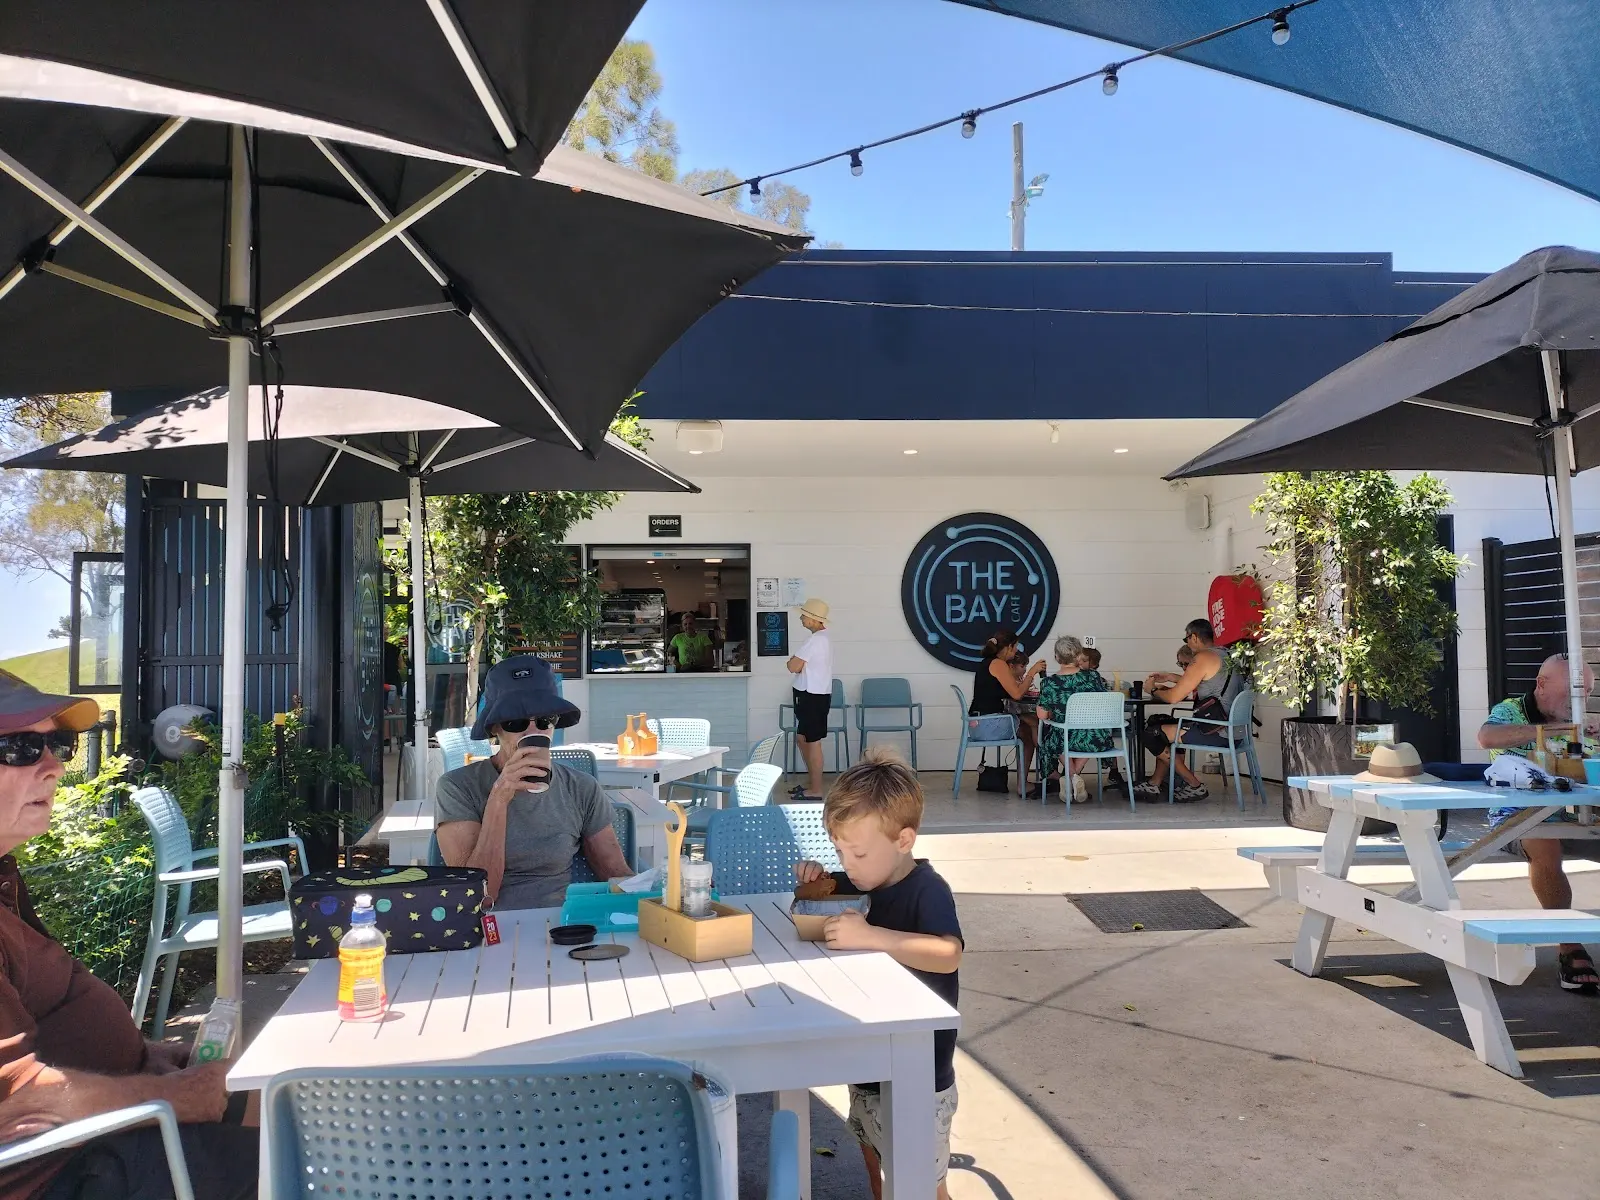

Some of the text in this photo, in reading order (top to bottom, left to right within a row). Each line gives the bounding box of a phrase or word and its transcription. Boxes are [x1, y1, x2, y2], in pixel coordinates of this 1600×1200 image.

[948, 561, 1015, 590] THE
[945, 594, 1009, 623] BAY
[1010, 595, 1021, 623] CAFE
[487, 921, 495, 932] 20
[489, 931, 498, 941] 23
